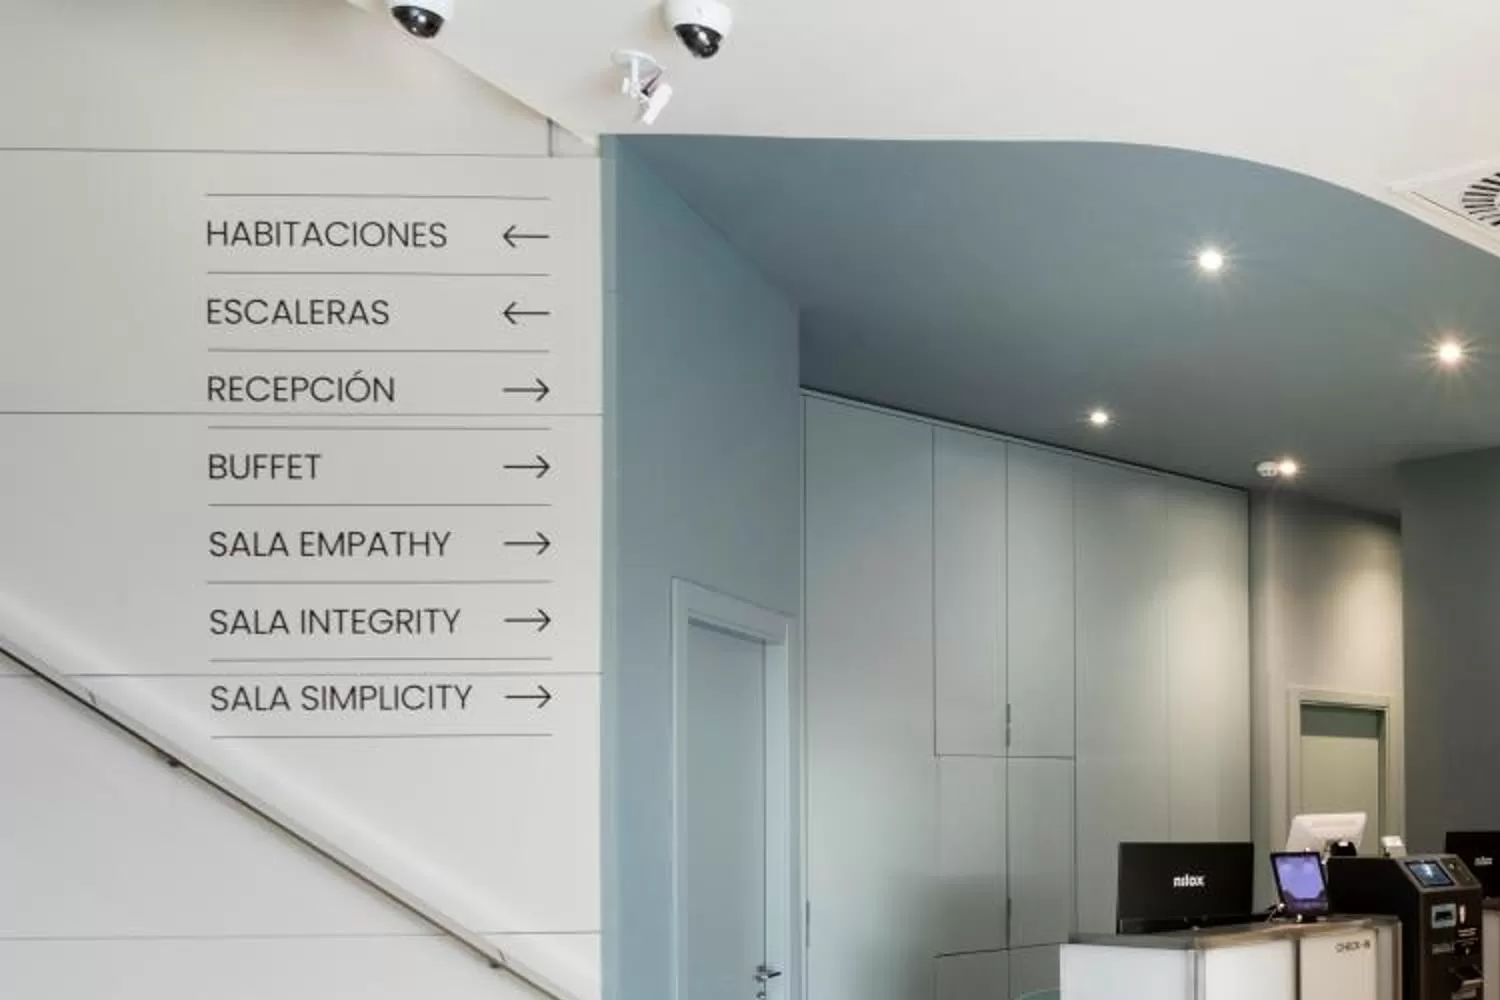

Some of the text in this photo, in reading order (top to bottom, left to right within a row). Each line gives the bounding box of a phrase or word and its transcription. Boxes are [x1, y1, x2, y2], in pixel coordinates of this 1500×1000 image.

[206, 219, 448, 249] HABITACIONES
[206, 298, 390, 326] ESCALERAS
[207, 369, 396, 403] RECEPCIÓN
[208, 453, 321, 481] BUFFET
[209, 530, 452, 558] SALA EMPATHY
[209, 607, 461, 636] SALA INTEGRITY
[210, 683, 473, 712] SALA SIMPLICITY
